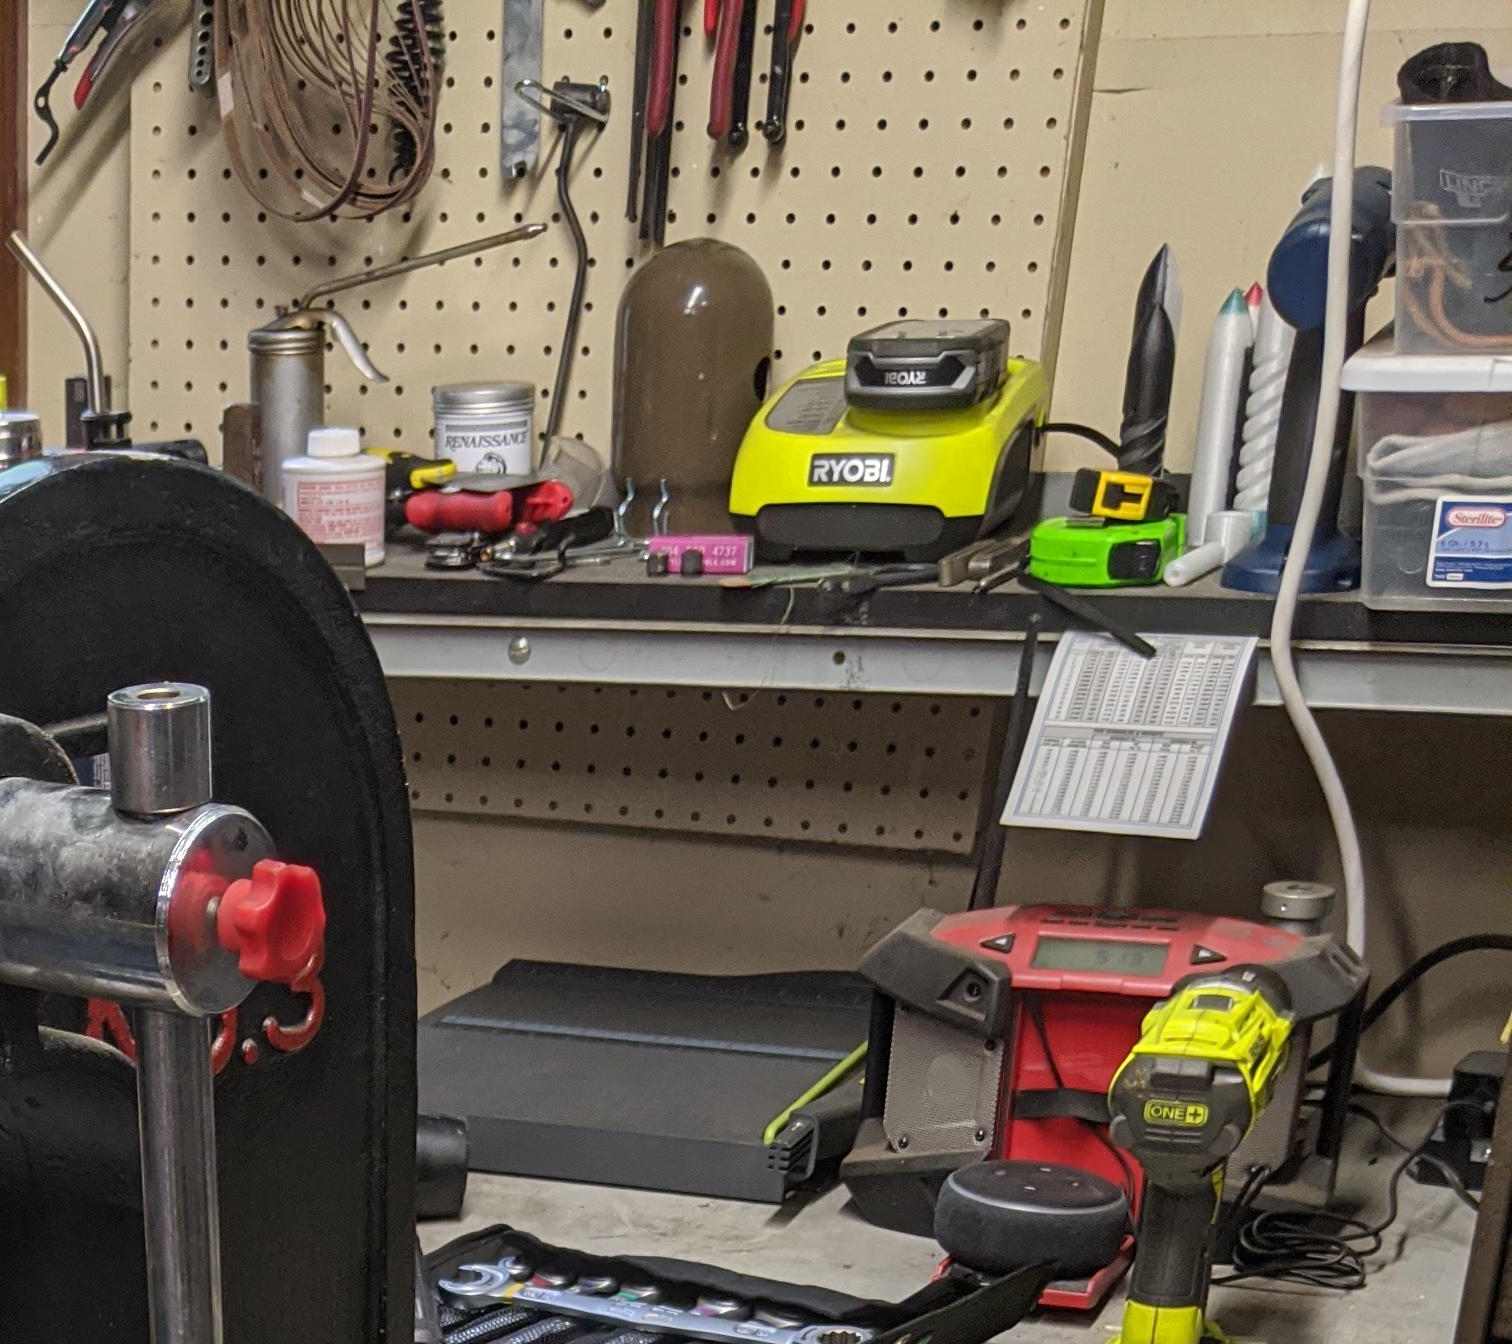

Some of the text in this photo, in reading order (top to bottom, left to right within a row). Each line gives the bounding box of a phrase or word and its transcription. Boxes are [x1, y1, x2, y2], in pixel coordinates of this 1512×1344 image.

[884, 371, 927, 385] RYOBI
[444, 430, 527, 452] RENAISSANCE
[812, 458, 891, 483] RYOBI
